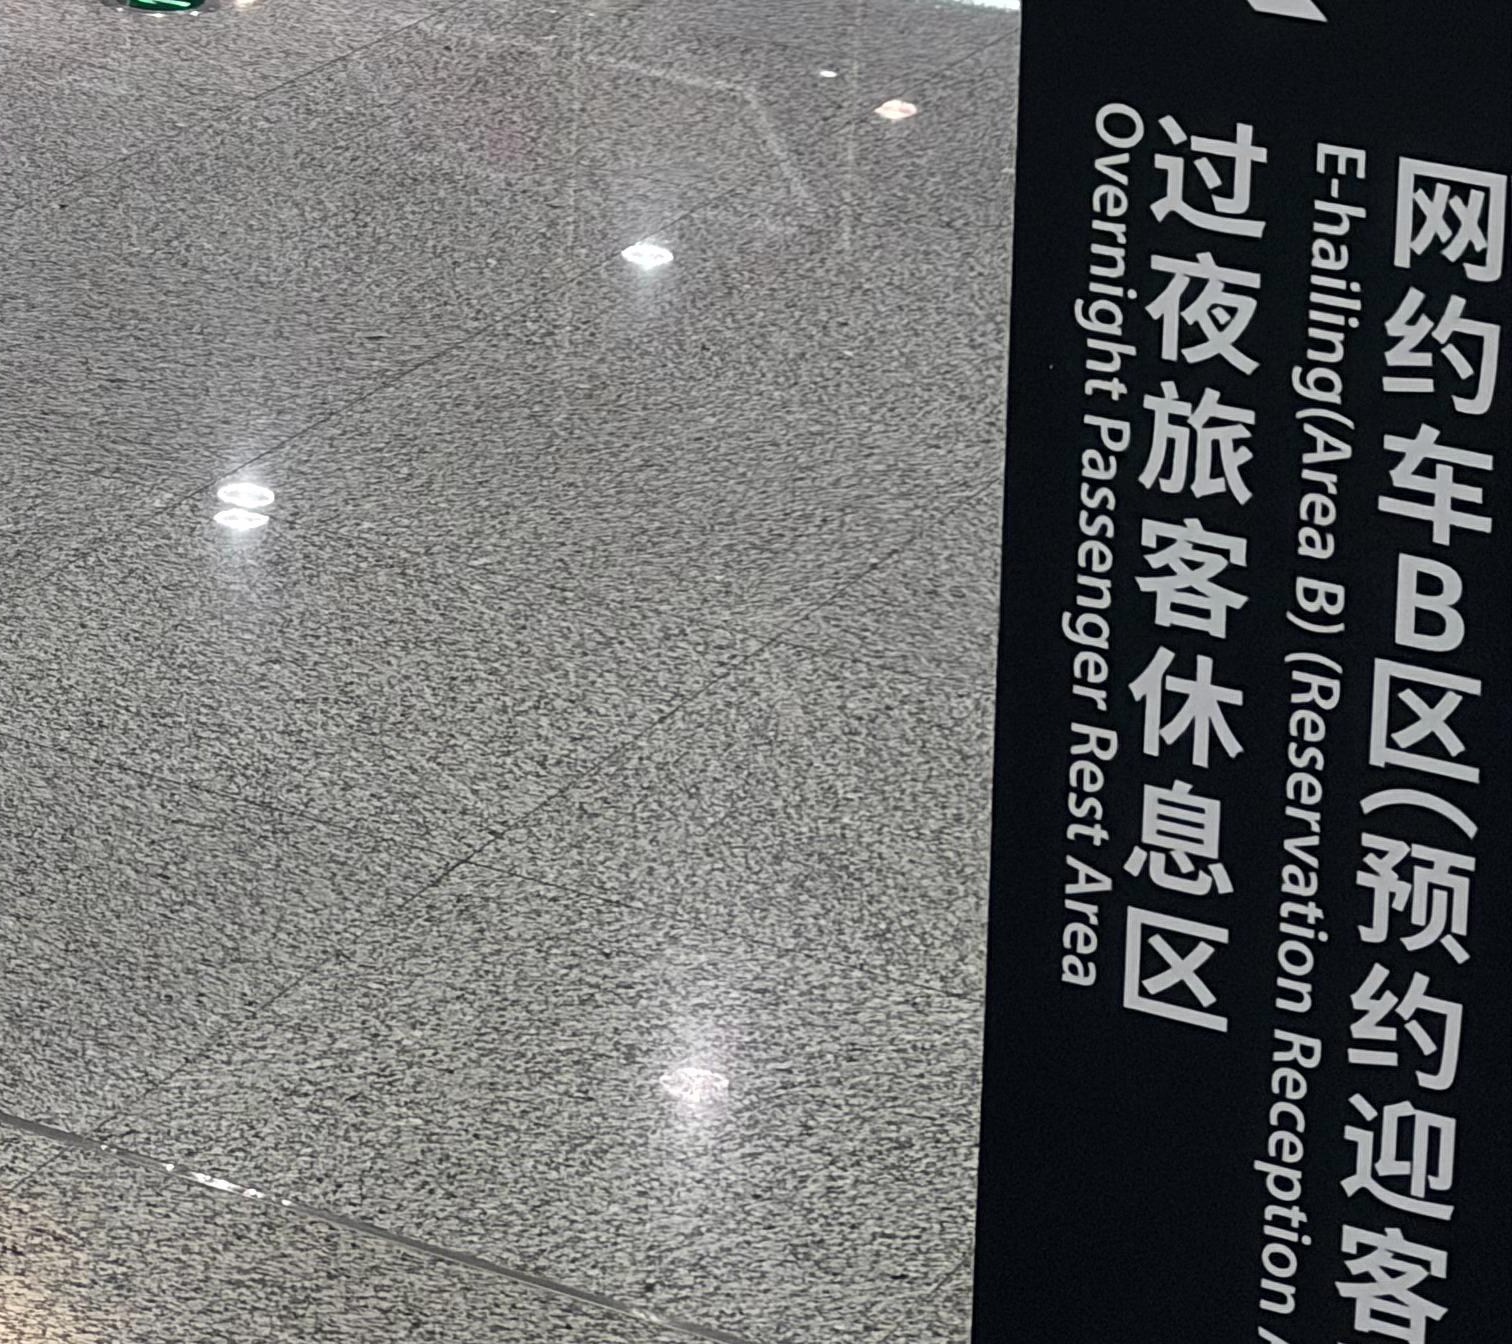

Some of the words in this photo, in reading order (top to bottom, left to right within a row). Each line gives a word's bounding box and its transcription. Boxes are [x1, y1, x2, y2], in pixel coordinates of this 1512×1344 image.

[1075, 102, 1145, 401] Overnight
[1291, 142, 1367, 560] E-hailing(Area
[1061, 413, 1131, 711] Passenger
[1123, 114, 1268, 1033] 过夜旅客休息区
[1286, 576, 1346, 634] B)
[1061, 854, 1113, 987] Area
[1066, 721, 1119, 846] Rest
[1275, 652, 1344, 1013] (Reservation
[1253, 1028, 1323, 1315] Reception
